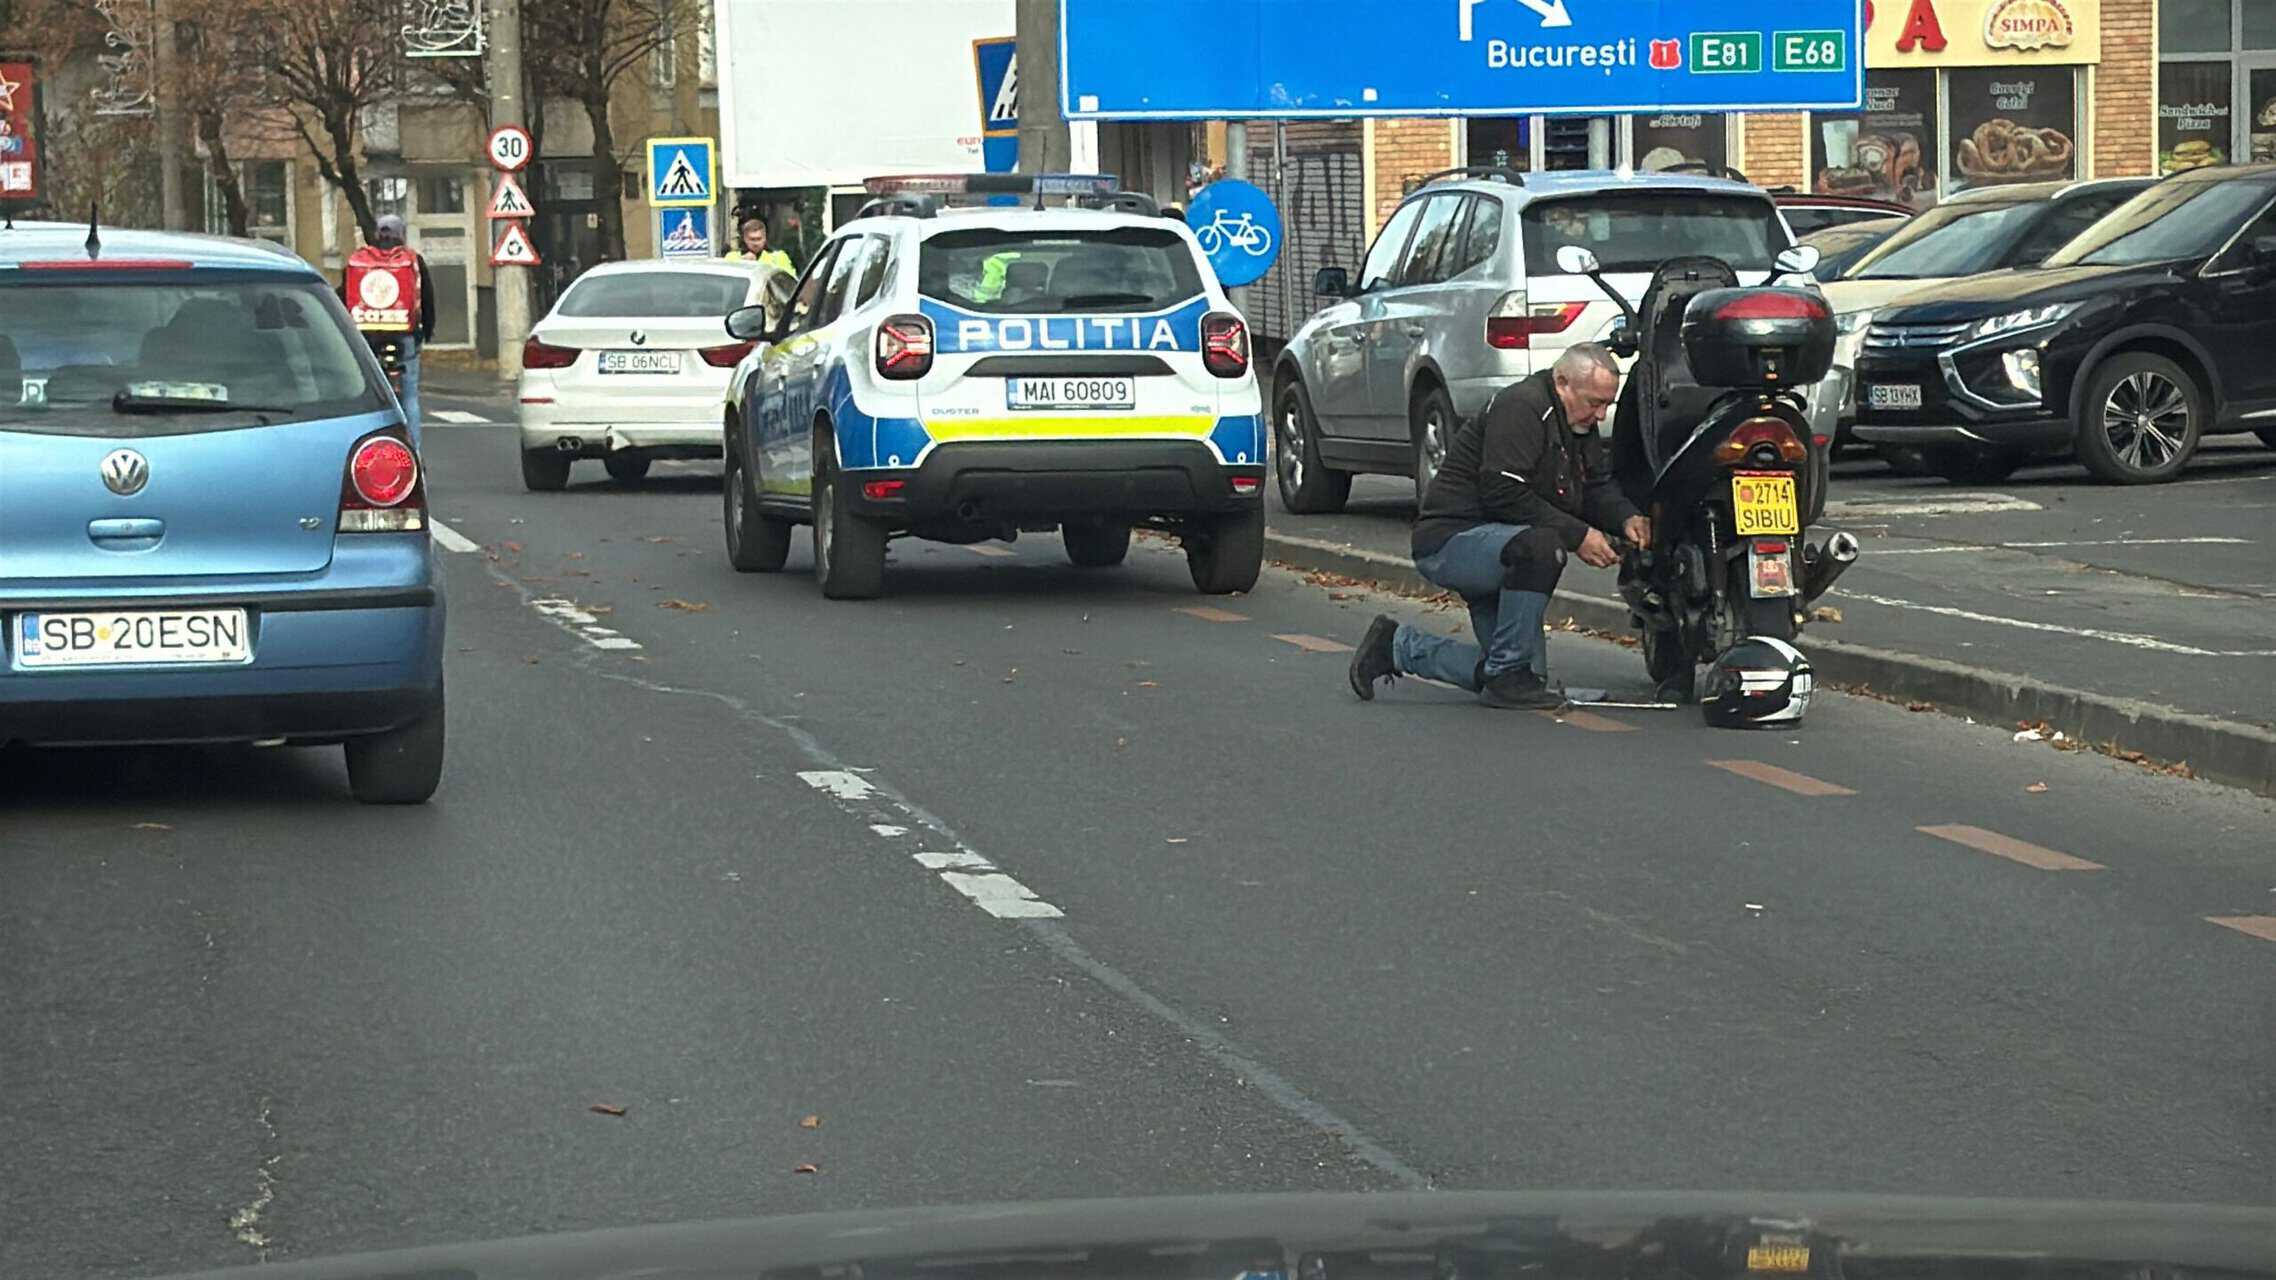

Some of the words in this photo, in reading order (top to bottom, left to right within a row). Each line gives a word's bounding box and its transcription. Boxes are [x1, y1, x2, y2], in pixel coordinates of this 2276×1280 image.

[1866, 0, 1948, 53] A
[2000, 18, 2060, 33] SIMPA
[1487, 38, 1636, 76] București
[1660, 46, 1668, 64] 1
[1702, 39, 1748, 66] E81
[1785, 37, 1836, 65] E68
[498, 137, 522, 158] 30
[957, 317, 1179, 351] POLITIA
[608, 355, 626, 369] SB
[632, 354, 676, 369] 06NCL
[1024, 378, 1056, 401] MAI
[1064, 377, 1127, 401] 60809
[1755, 482, 1789, 505] 2714
[1743, 508, 1792, 529] SIBIU
[44, 617, 96, 650] SB
[113, 614, 237, 649] 20ESN
